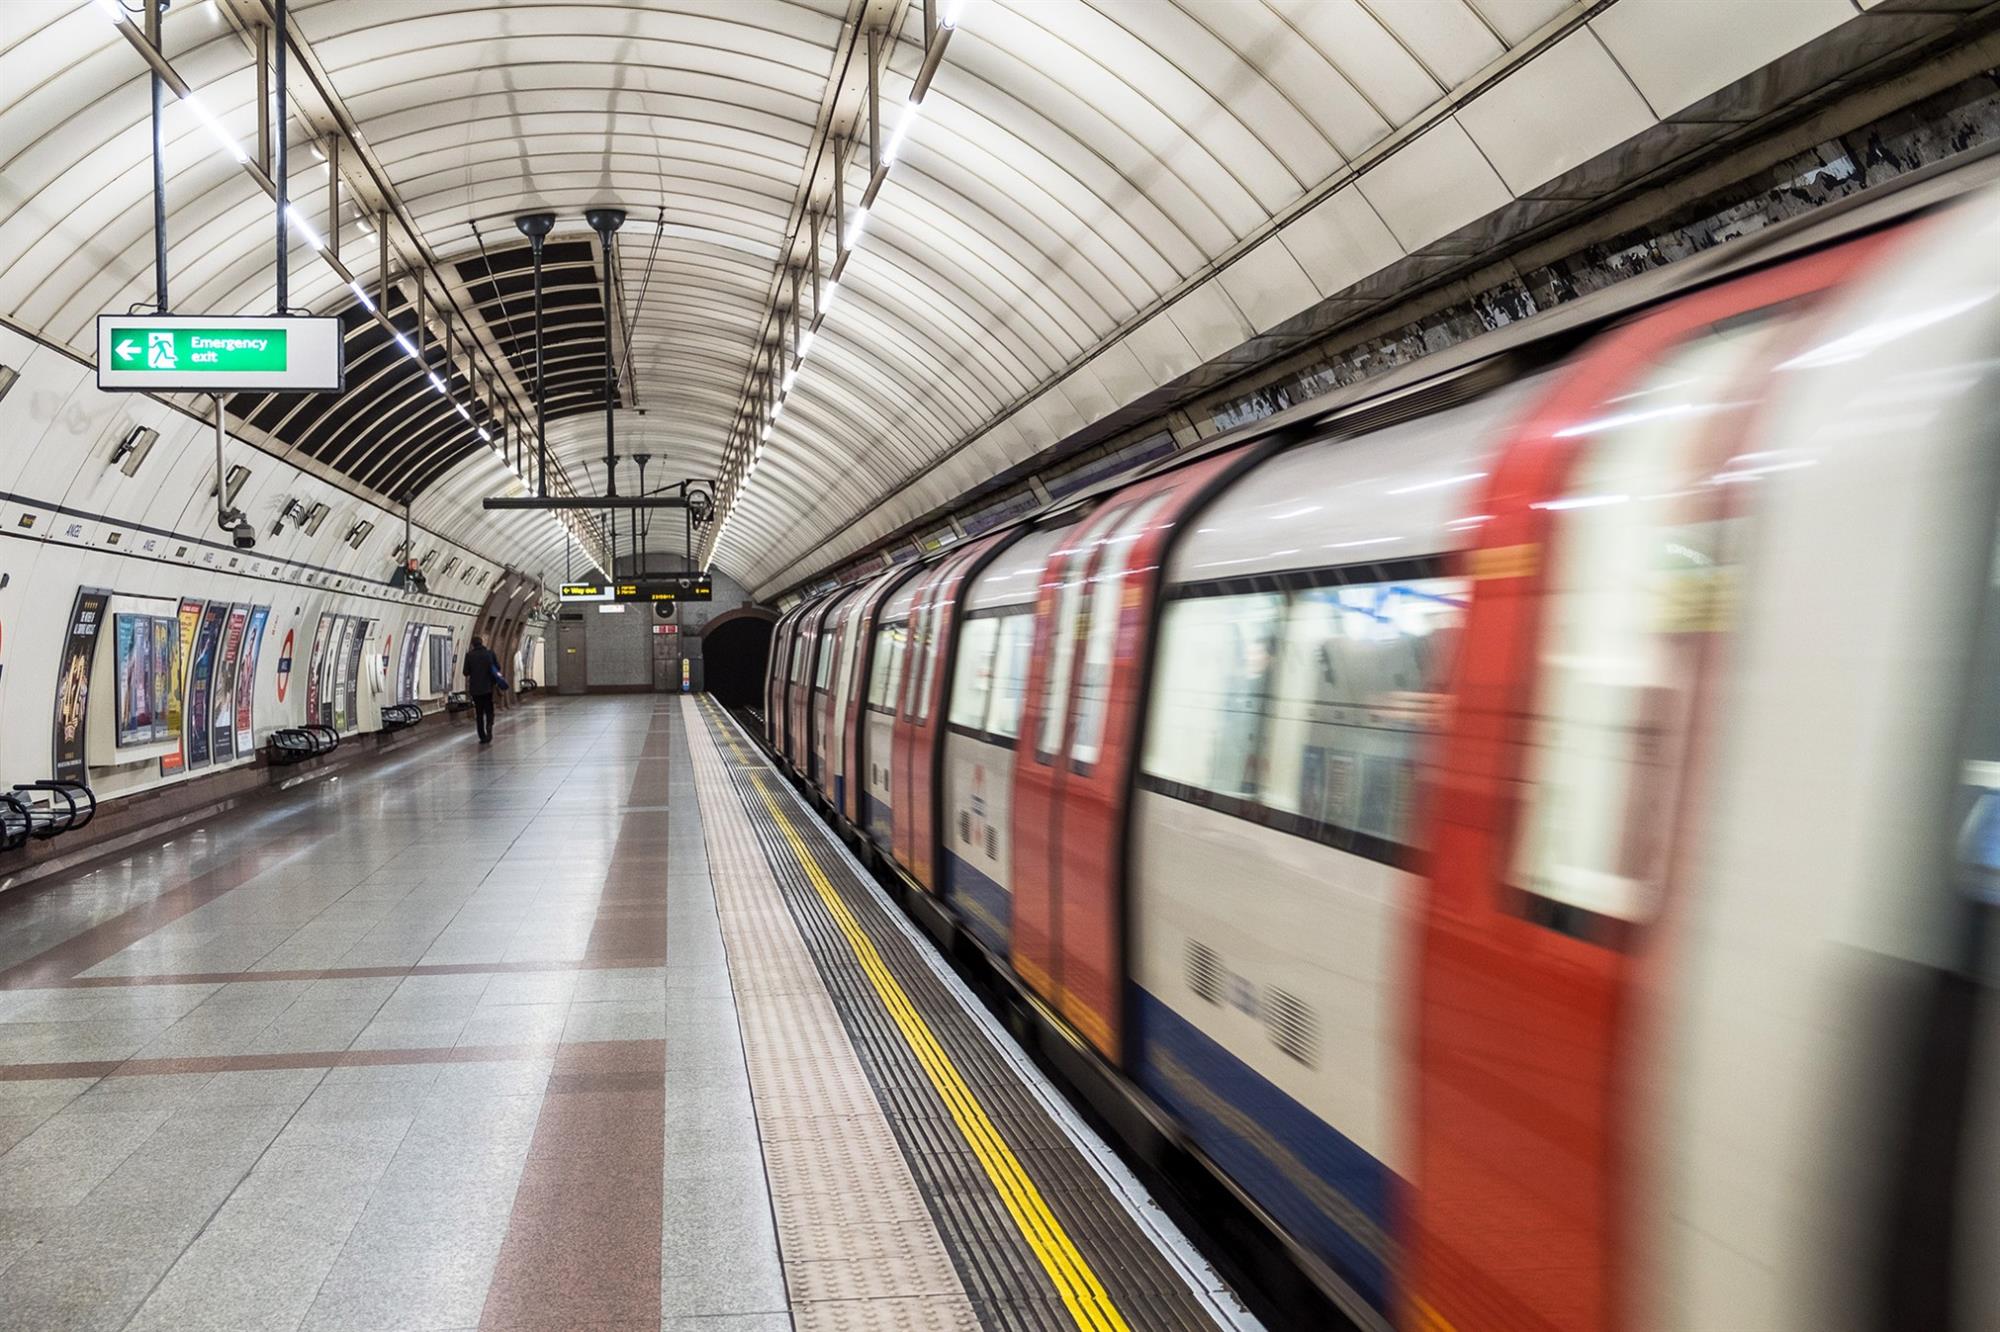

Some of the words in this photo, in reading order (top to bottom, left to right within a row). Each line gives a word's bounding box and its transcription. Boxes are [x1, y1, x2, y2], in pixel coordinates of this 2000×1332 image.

[191, 336, 268, 351] Emergency
[191, 351, 219, 363] exit
[571, 587, 585, 595] Way
